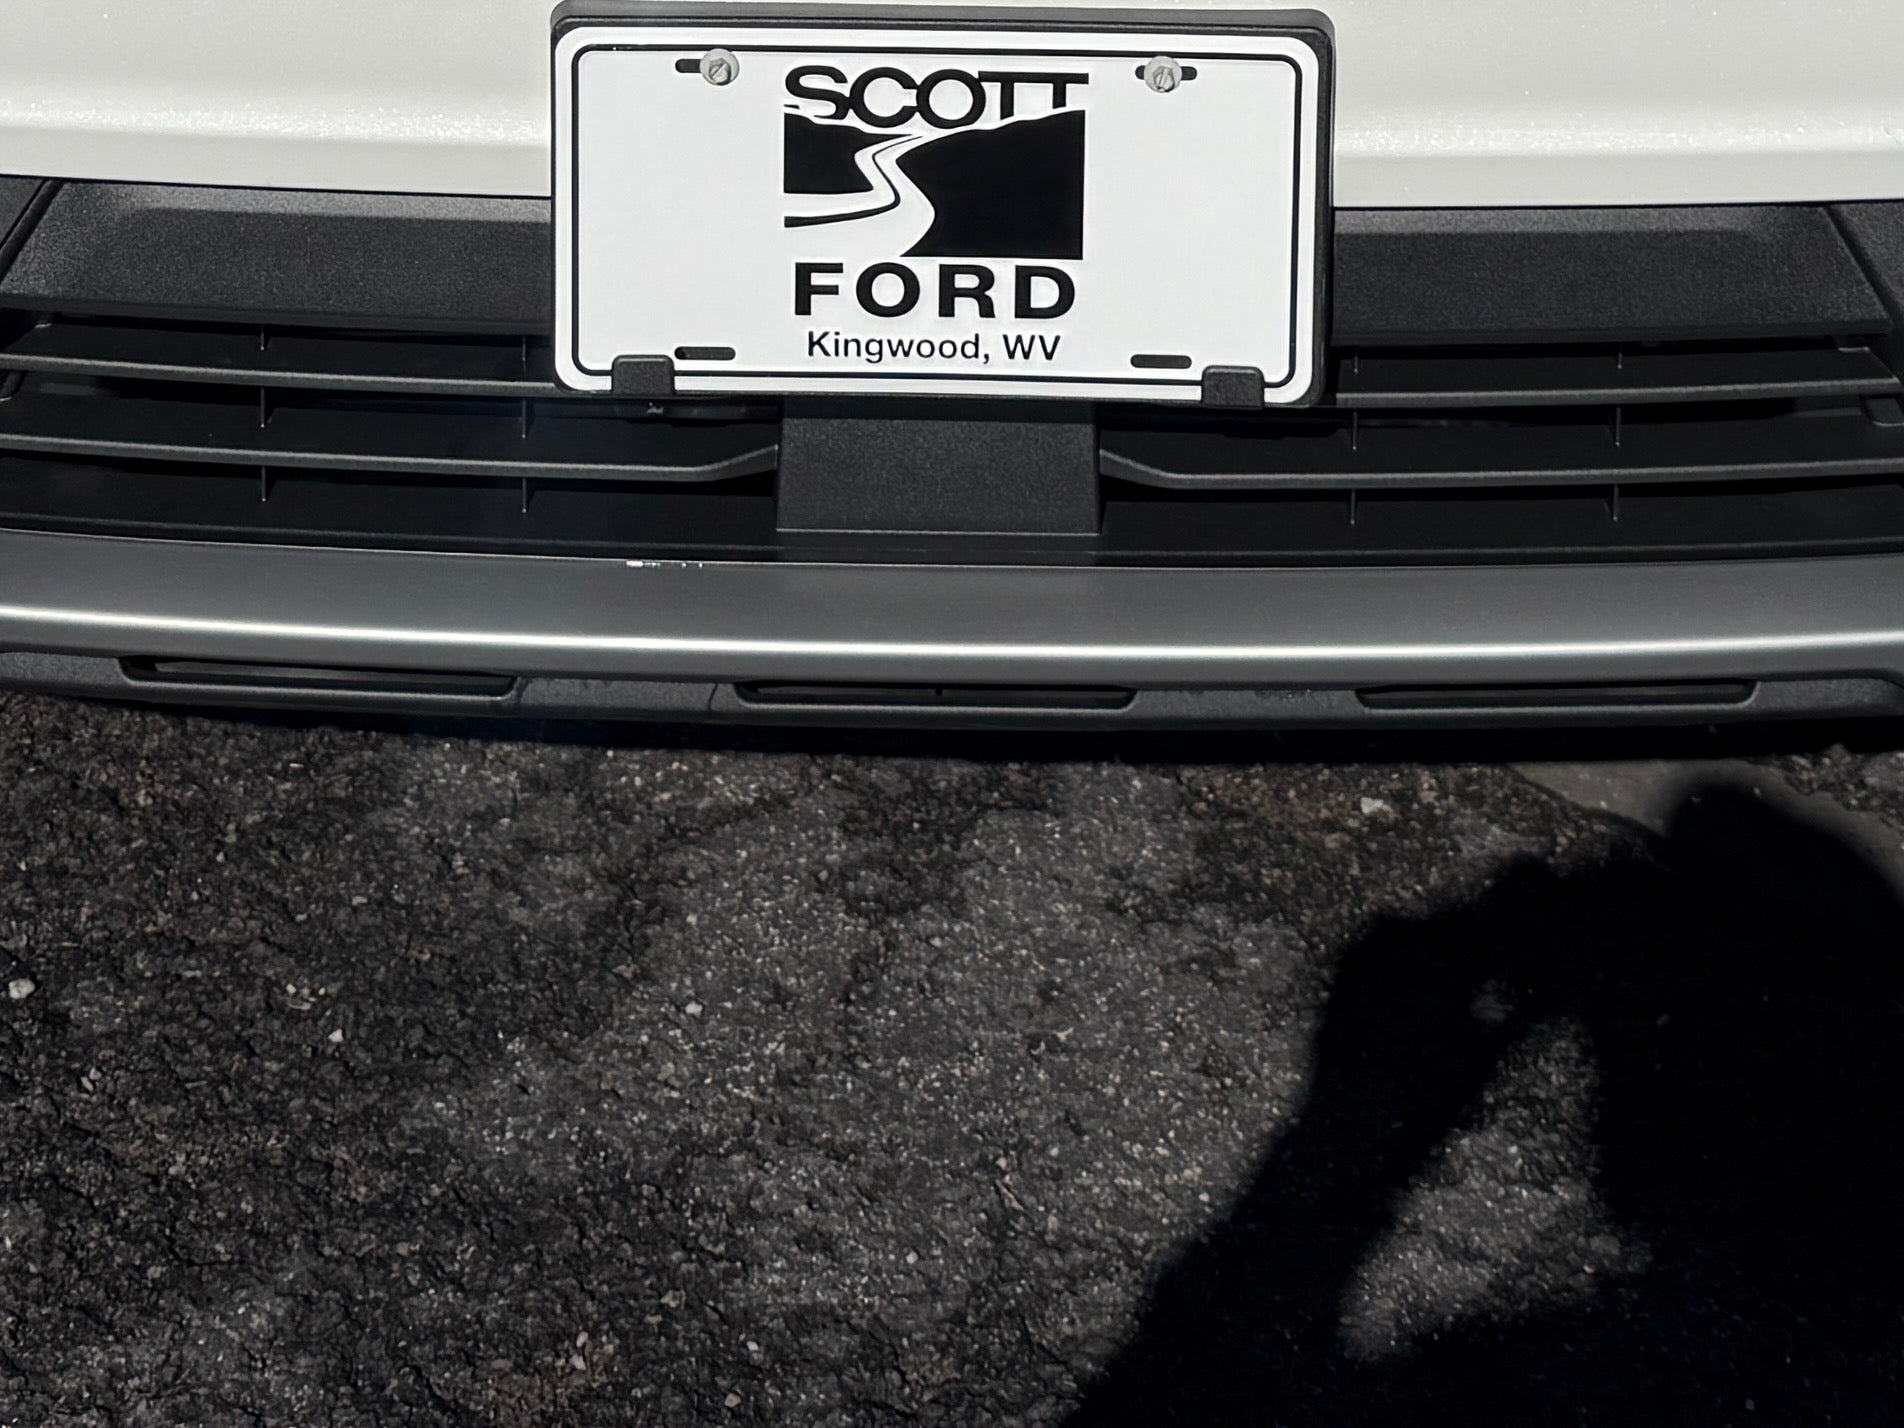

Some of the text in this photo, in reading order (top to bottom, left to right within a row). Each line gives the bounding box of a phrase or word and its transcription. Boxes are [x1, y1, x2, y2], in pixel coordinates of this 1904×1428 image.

[785, 65, 1089, 129] SCOTT
[794, 262, 1076, 319] FORD
[807, 331, 1061, 364] Kingwood, WV
